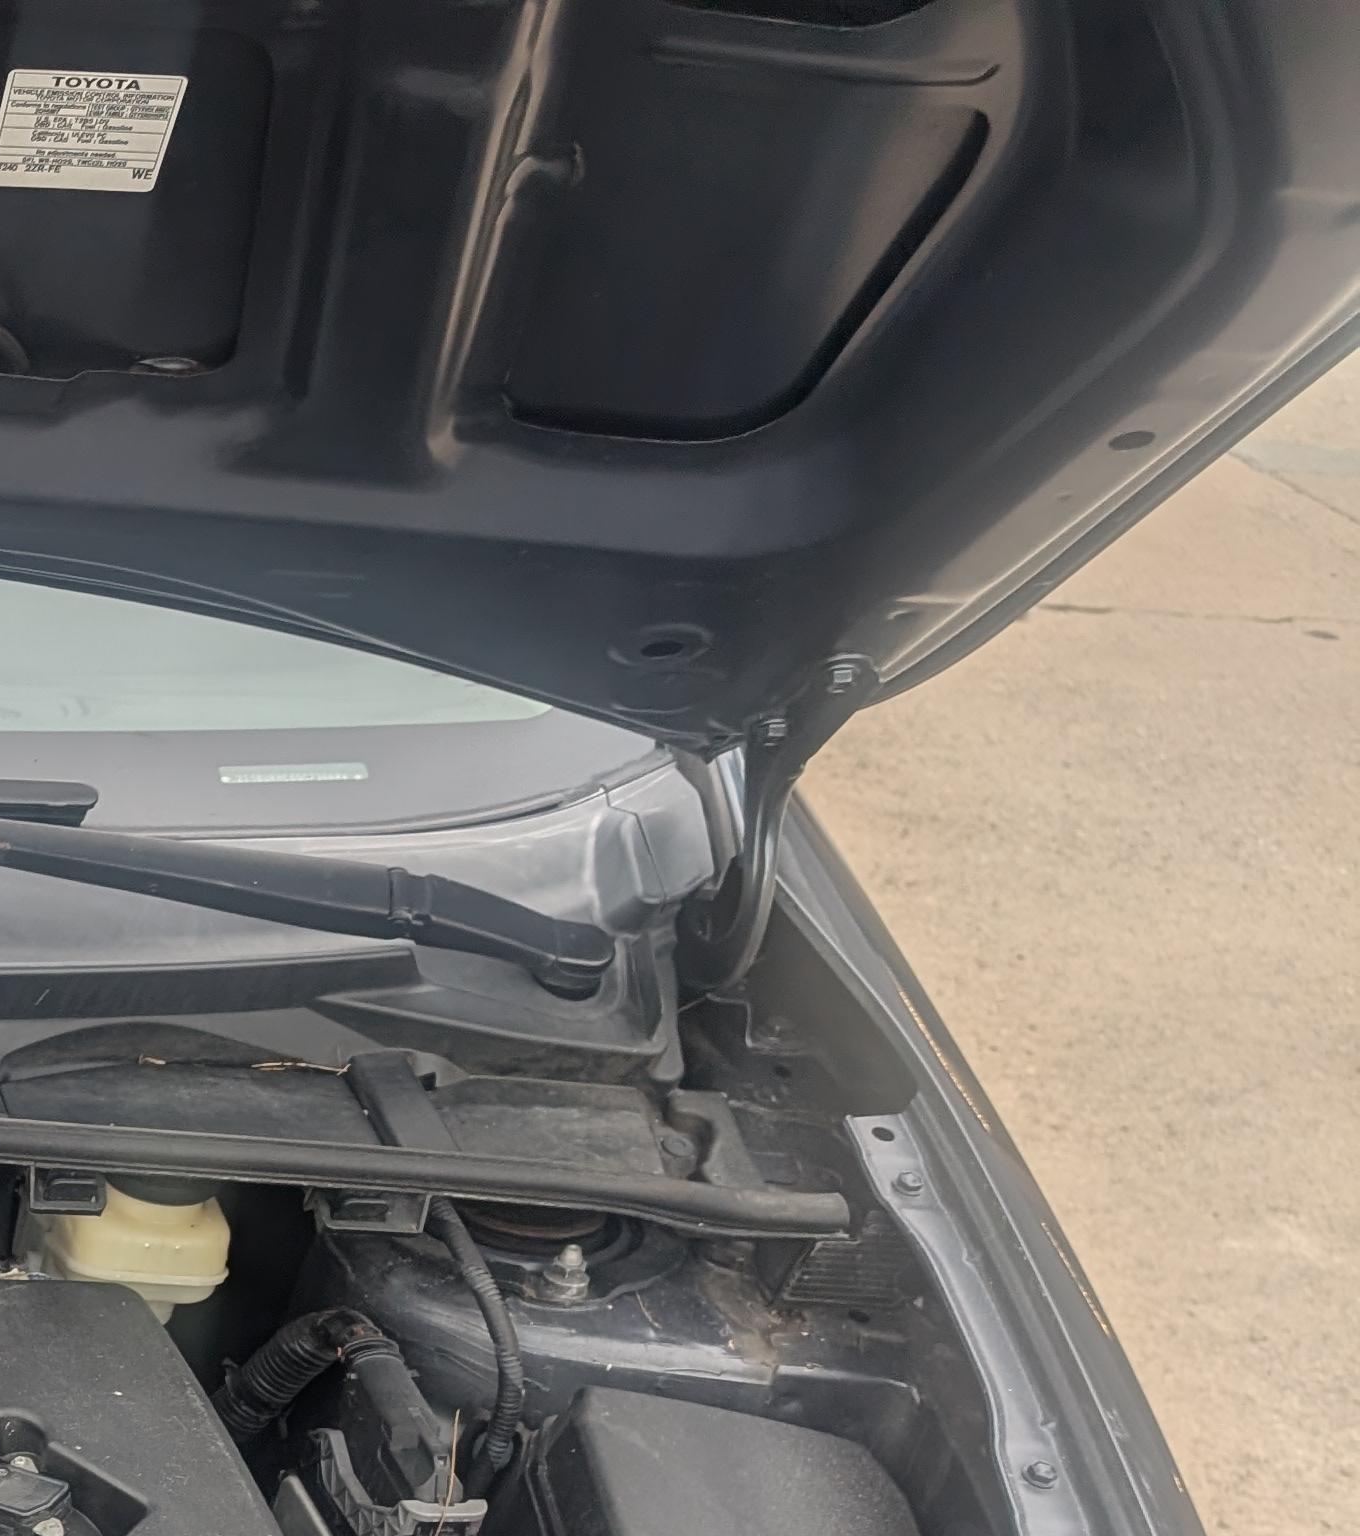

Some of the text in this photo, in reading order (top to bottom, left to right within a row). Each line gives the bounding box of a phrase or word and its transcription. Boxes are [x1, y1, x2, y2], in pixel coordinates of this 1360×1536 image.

[52, 76, 140, 91] TOYOTA
[24, 164, 62, 173] 2ZR-FE
[131, 168, 154, 180] WE
